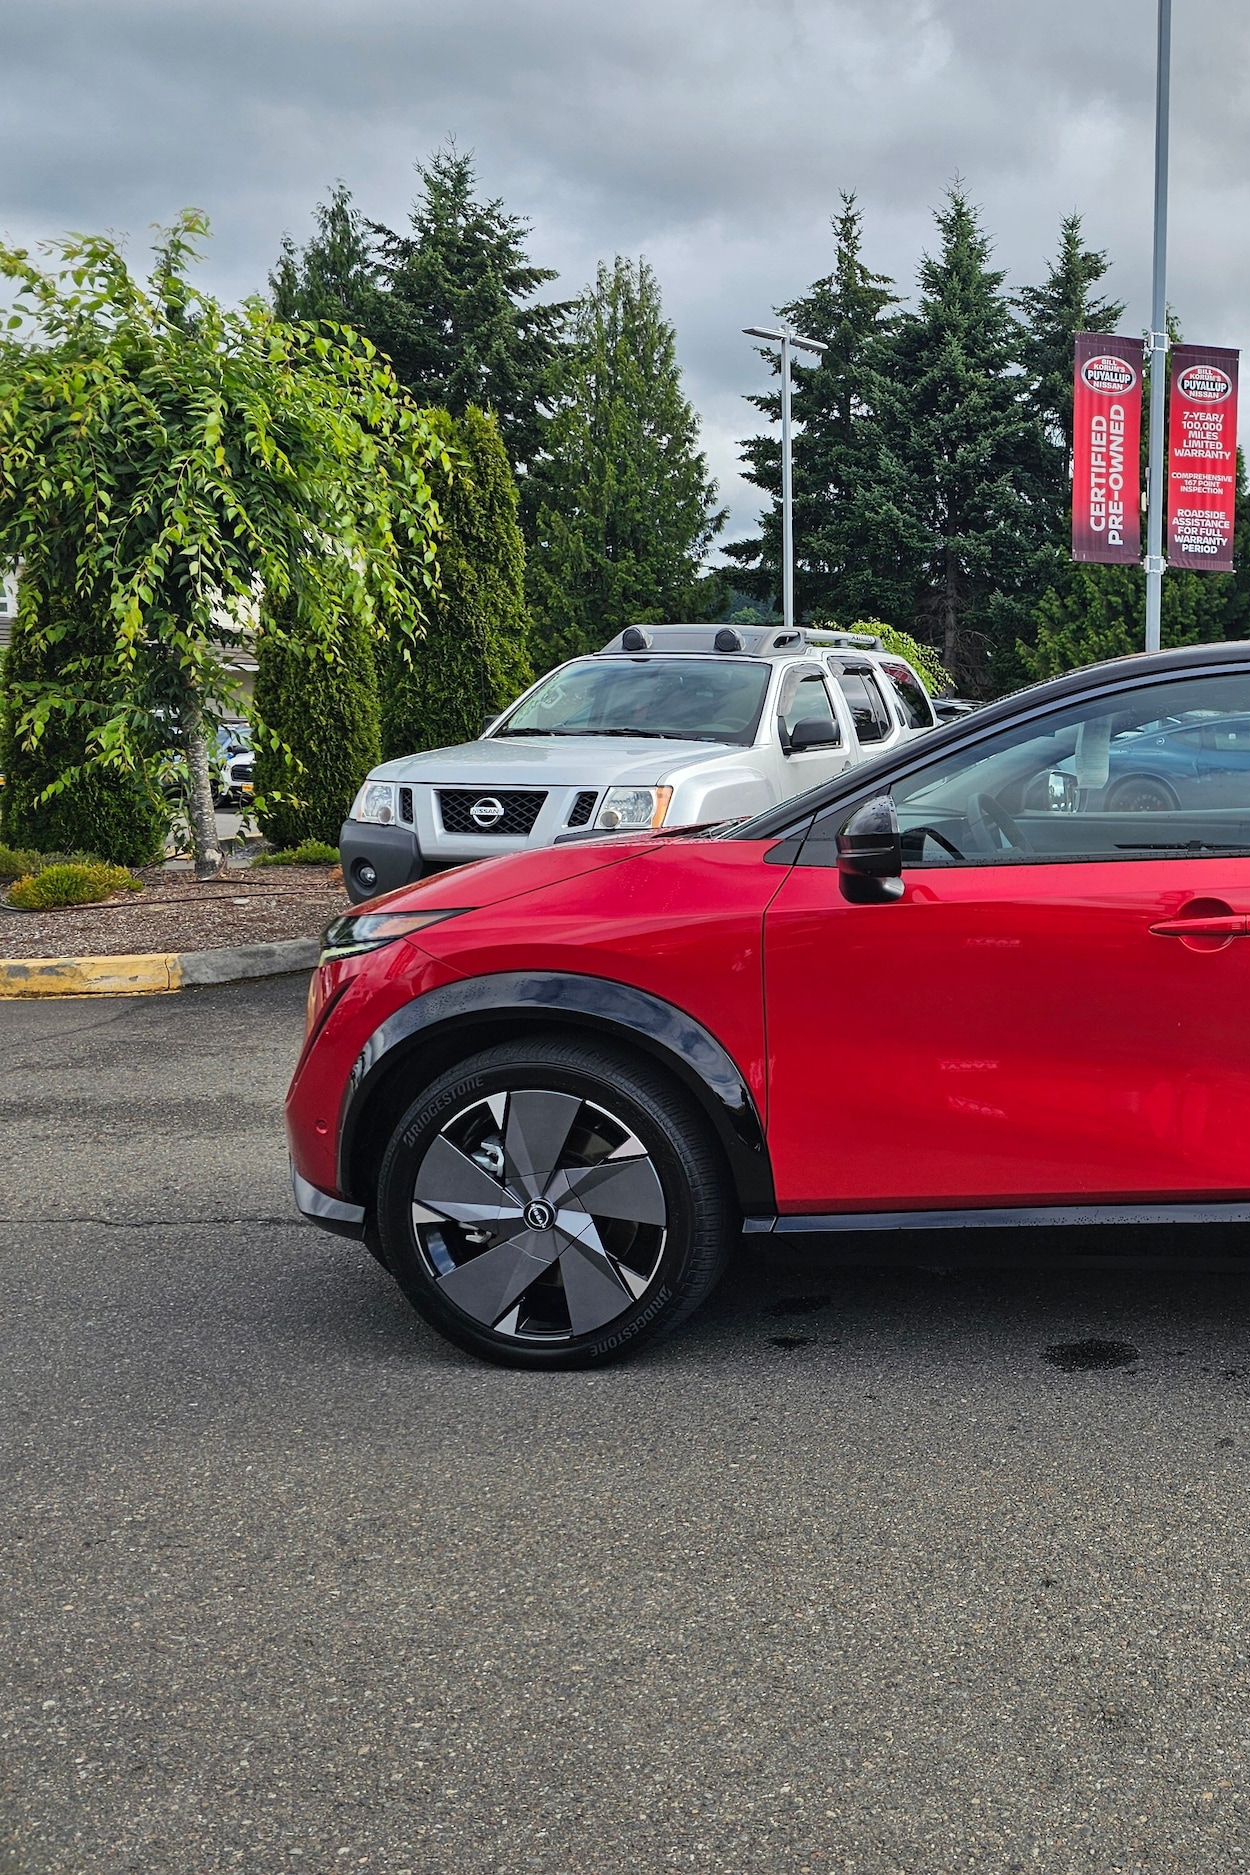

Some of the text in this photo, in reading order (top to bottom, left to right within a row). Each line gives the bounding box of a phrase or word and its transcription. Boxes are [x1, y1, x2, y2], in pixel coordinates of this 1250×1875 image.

[1101, 358, 1117, 366] BILL
[1093, 364, 1126, 373] KORUM'S
[1197, 368, 1213, 376] BILL
[1087, 369, 1131, 384] PUYALLUP
[1189, 373, 1222, 382] KORUM'S
[1093, 380, 1124, 391] NISSAN
[1183, 379, 1227, 392] PUYALLUP
[1189, 389, 1220, 399] NISSAN
[1183, 411, 1225, 423] 7-YEAR/
[1181, 420, 1223, 432] 100,000
[1188, 431, 1218, 441] MILES
[1183, 439, 1223, 450] LIMITED
[1174, 448, 1231, 460] WARRANTY
[1089, 415, 1107, 532] CERTIFIED
[1108, 404, 1125, 546] PRE-OWNED
[1171, 471, 1233, 483] COMPREHENSIVE
[1180, 485, 1224, 495] INSPECTION
[1198, 480, 1221, 488] POINT
[1177, 508, 1226, 520] ROADSIDE
[1172, 517, 1230, 529] ASSISTANCE
[1177, 526, 1223, 537] FOR FULL
[1174, 534, 1228, 546] WARRANTY
[1181, 543, 1218, 554] PERIOD
[402, 1076, 485, 1149] BRIDGESTONE
[588, 1283, 673, 1358] BRIDGESTONE
